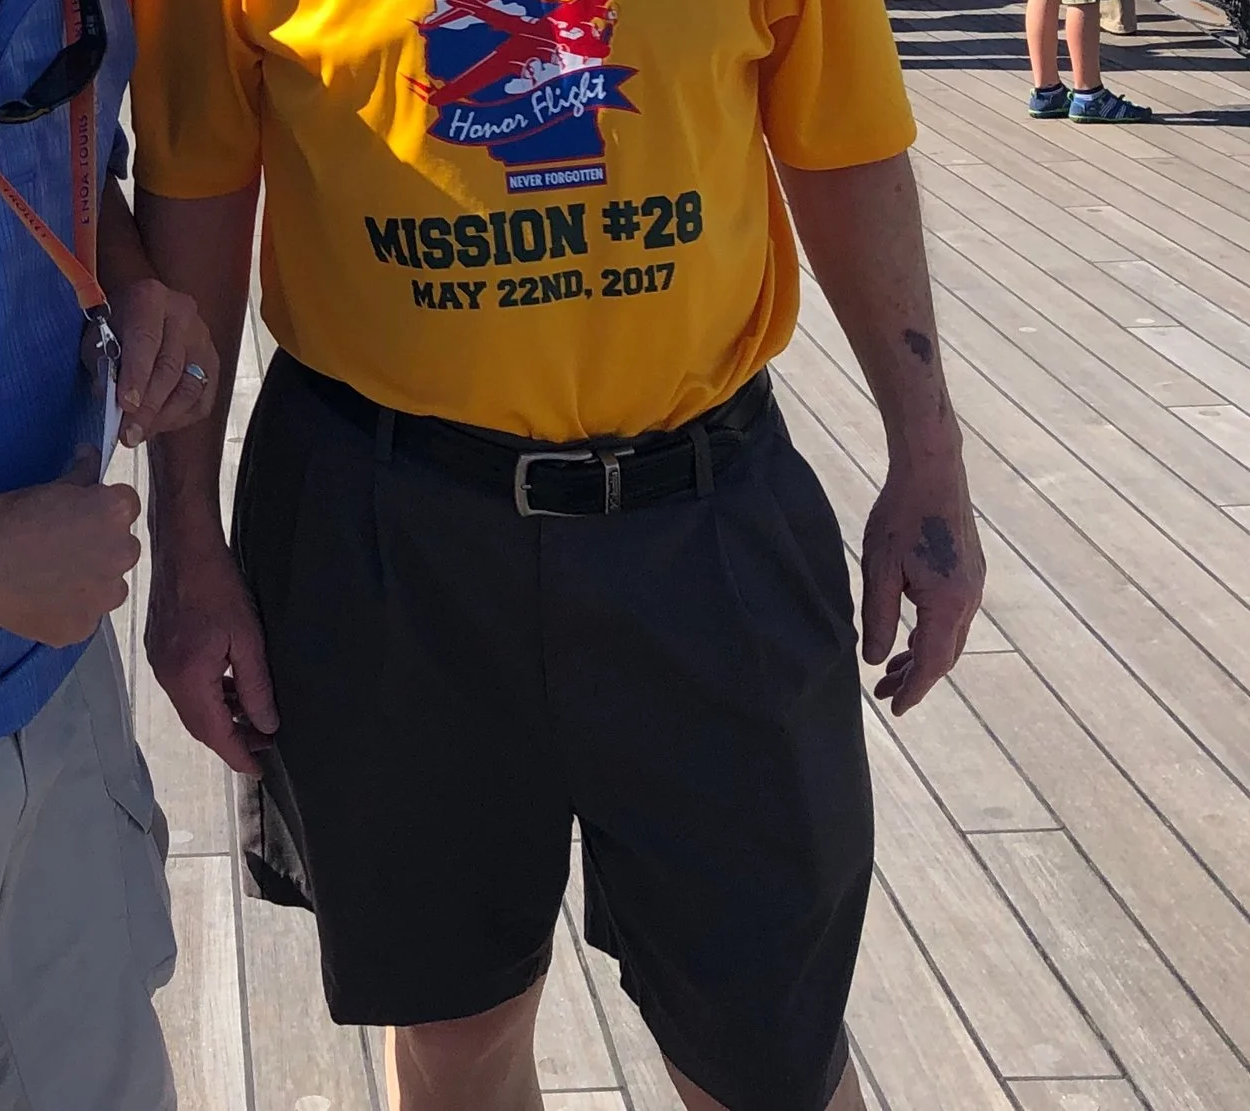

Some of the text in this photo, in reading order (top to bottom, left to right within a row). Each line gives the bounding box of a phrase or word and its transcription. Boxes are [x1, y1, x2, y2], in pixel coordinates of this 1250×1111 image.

[449, 73, 608, 142] Honor Flight
[78, 114, 89, 167] TOURS
[79, 172, 90, 212] NOA
[509, 167, 604, 189] NEVER FORGOTTEN
[364, 190, 703, 270] MISSION #28
[411, 262, 676, 310] MAY 22ND, 2017
